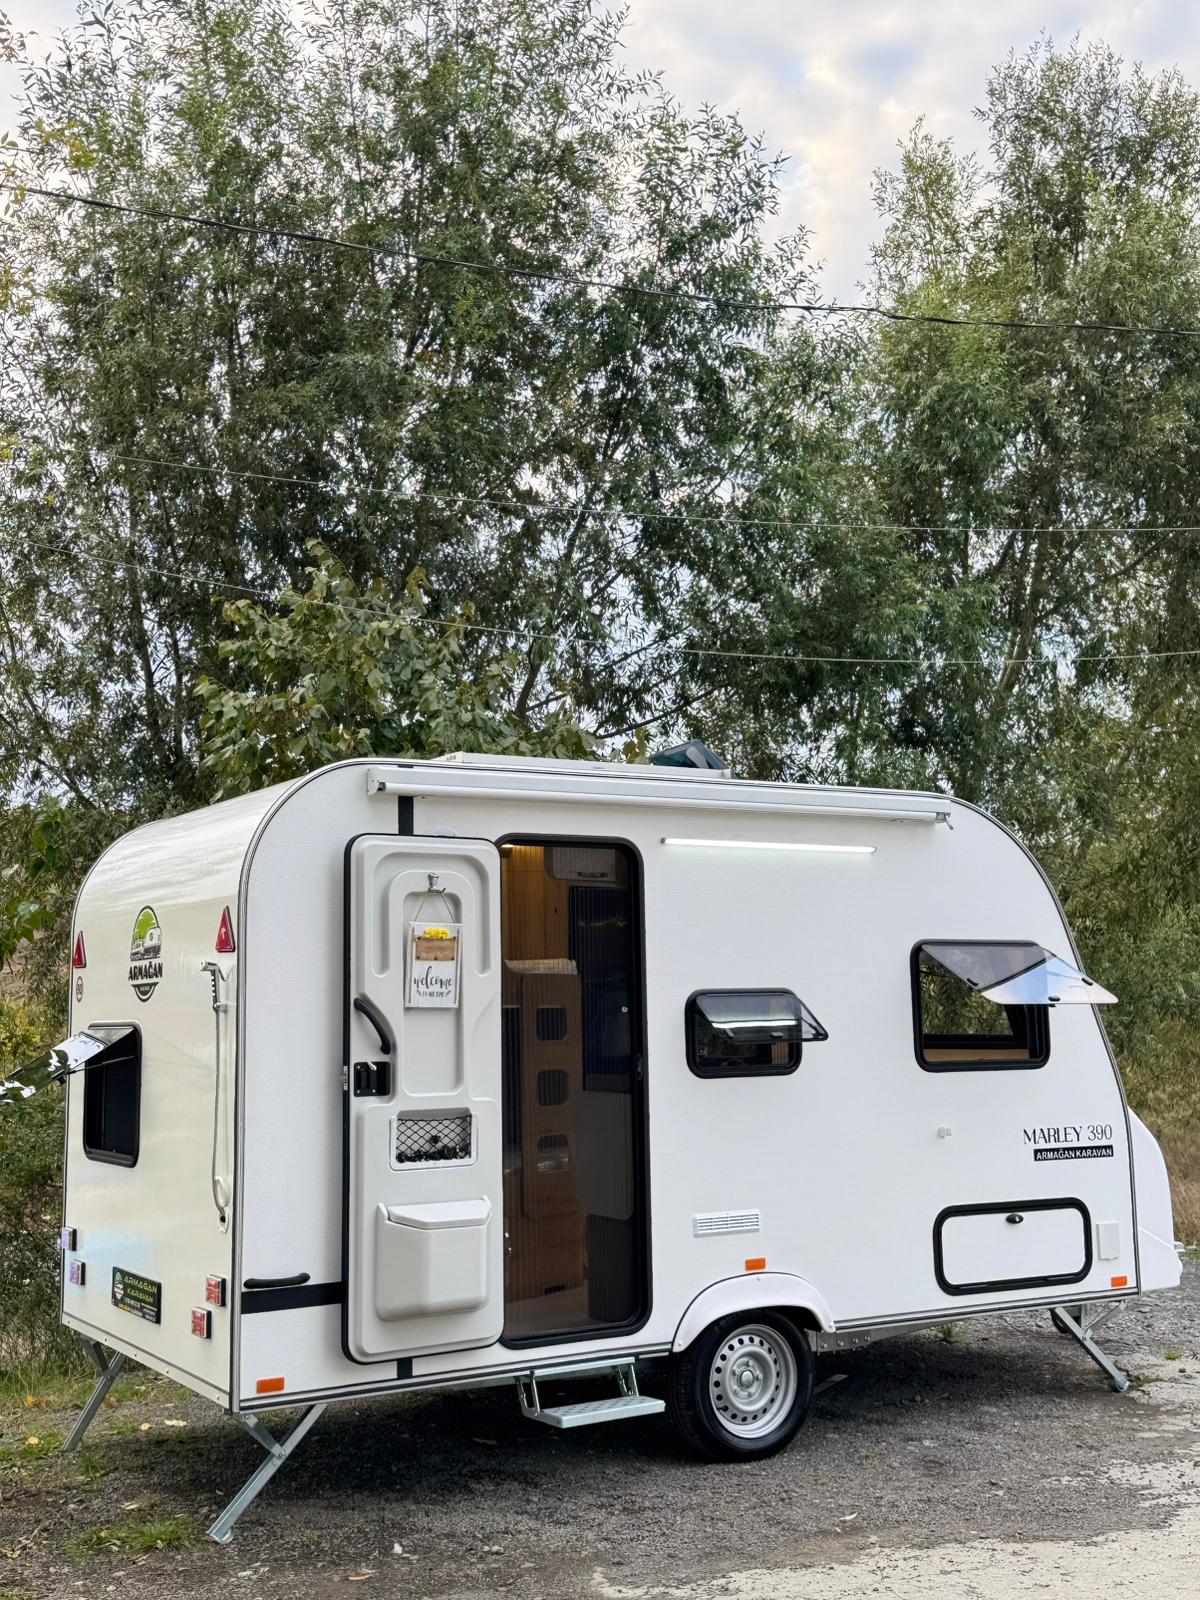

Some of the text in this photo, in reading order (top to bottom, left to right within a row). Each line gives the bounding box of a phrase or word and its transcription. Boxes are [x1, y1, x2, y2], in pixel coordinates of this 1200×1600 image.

[128, 961, 163, 981] ARMAĞAN
[413, 965, 452, 990] welcome
[1023, 1124, 1113, 1145] MARLEY 390
[1036, 1147, 1112, 1160] ARMAĞAN KARAVAN
